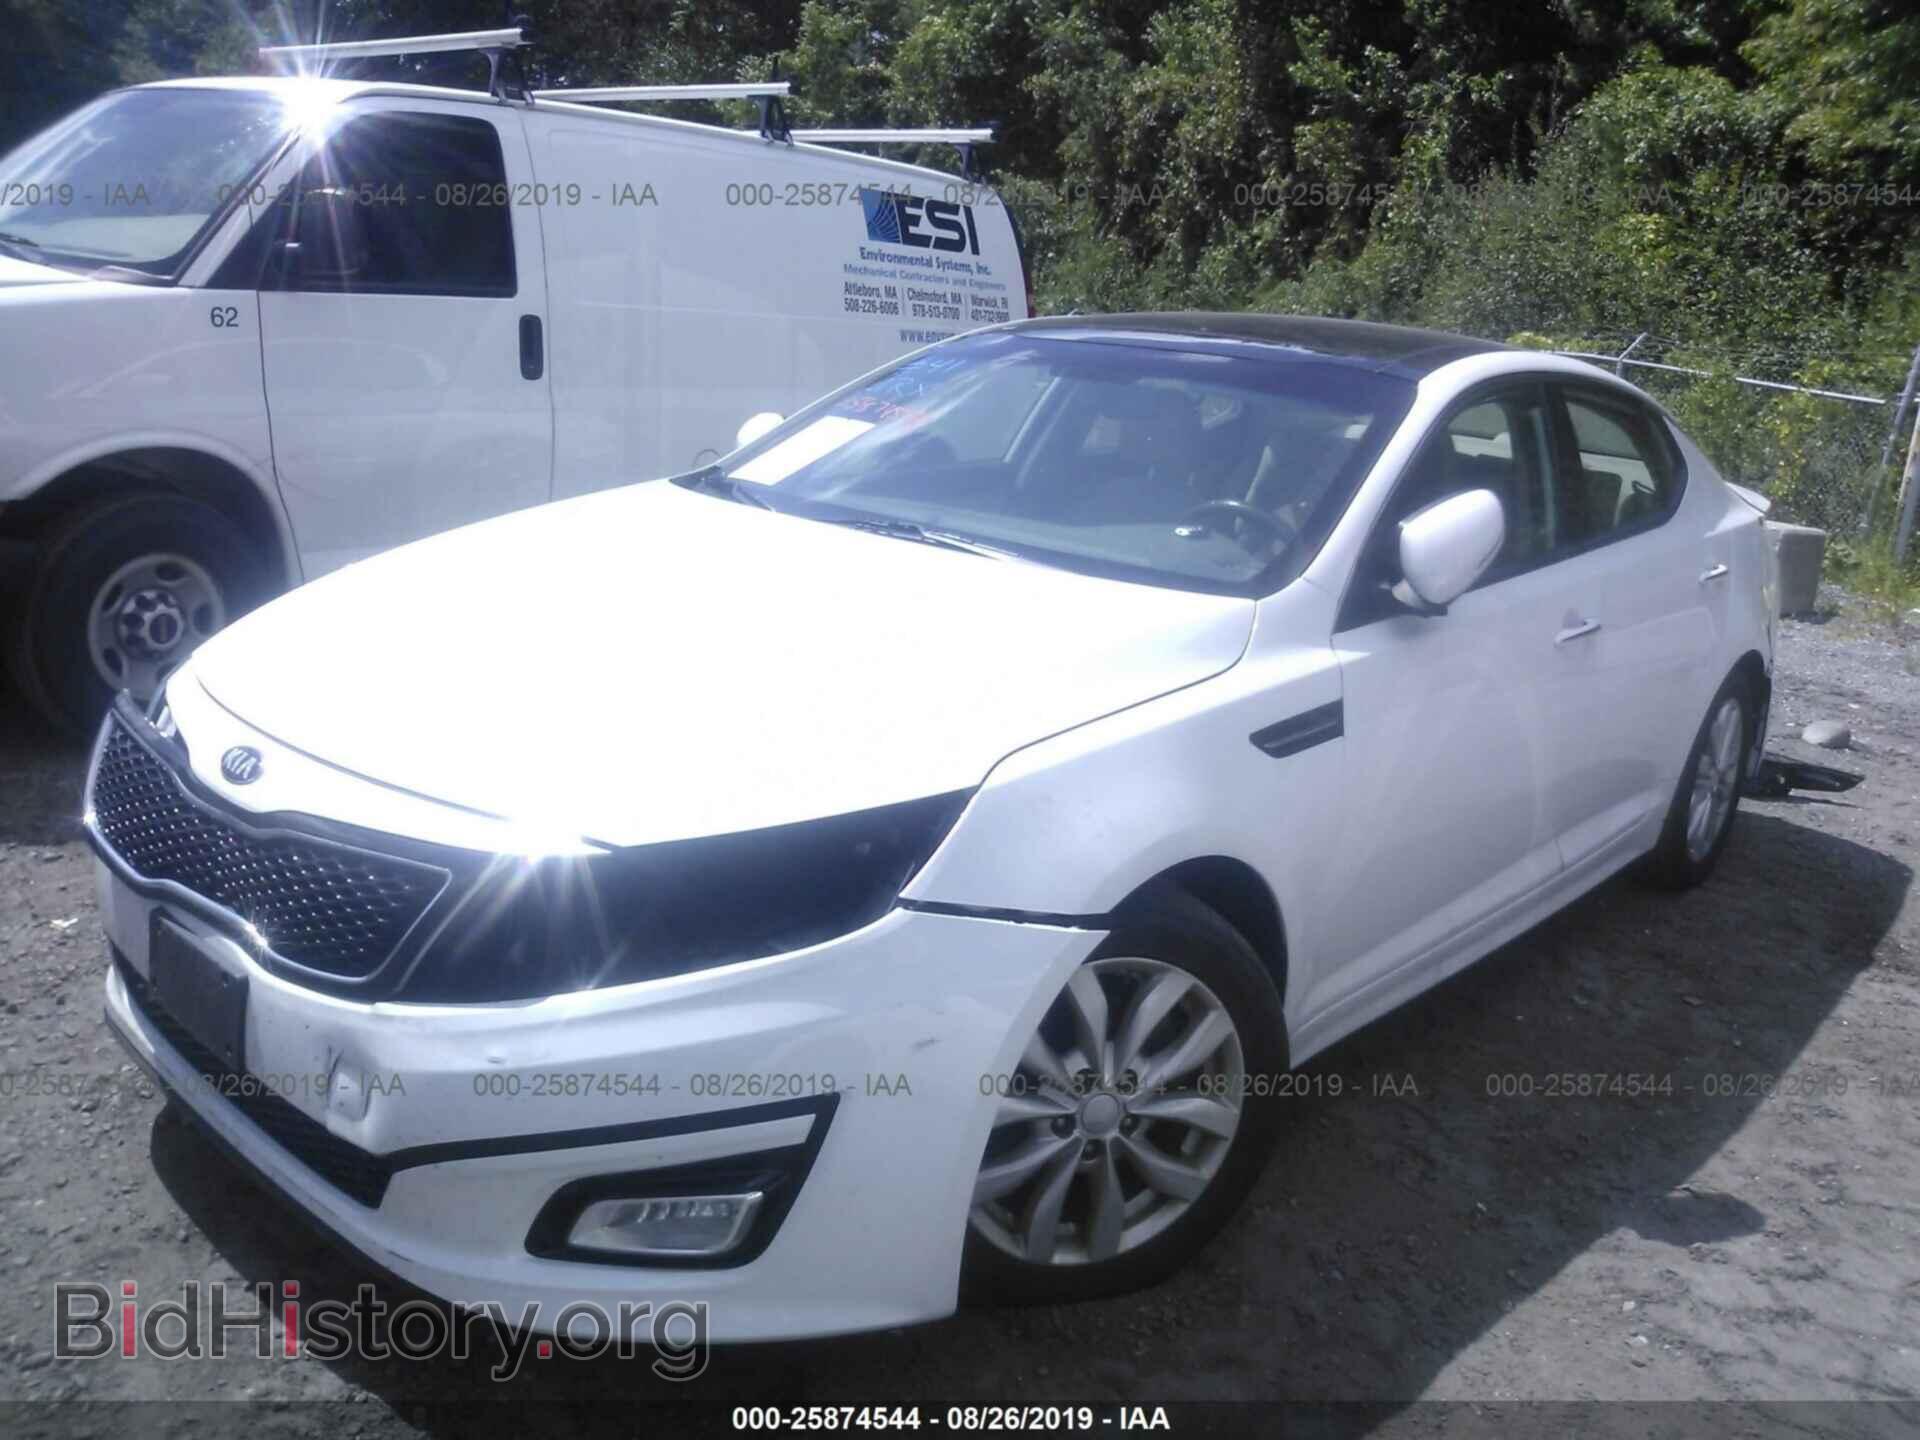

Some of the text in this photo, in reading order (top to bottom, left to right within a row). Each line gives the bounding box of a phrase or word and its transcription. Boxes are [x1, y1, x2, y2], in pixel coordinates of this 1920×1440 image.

[893, 193, 980, 256] ESI
[860, 246, 991, 276] Environmental Systems, Inc.
[845, 281, 897, 299] Attleboro, MA
[951, 291, 961, 304] MA
[211, 306, 239, 328] 62
[223, 747, 257, 779] KIA
